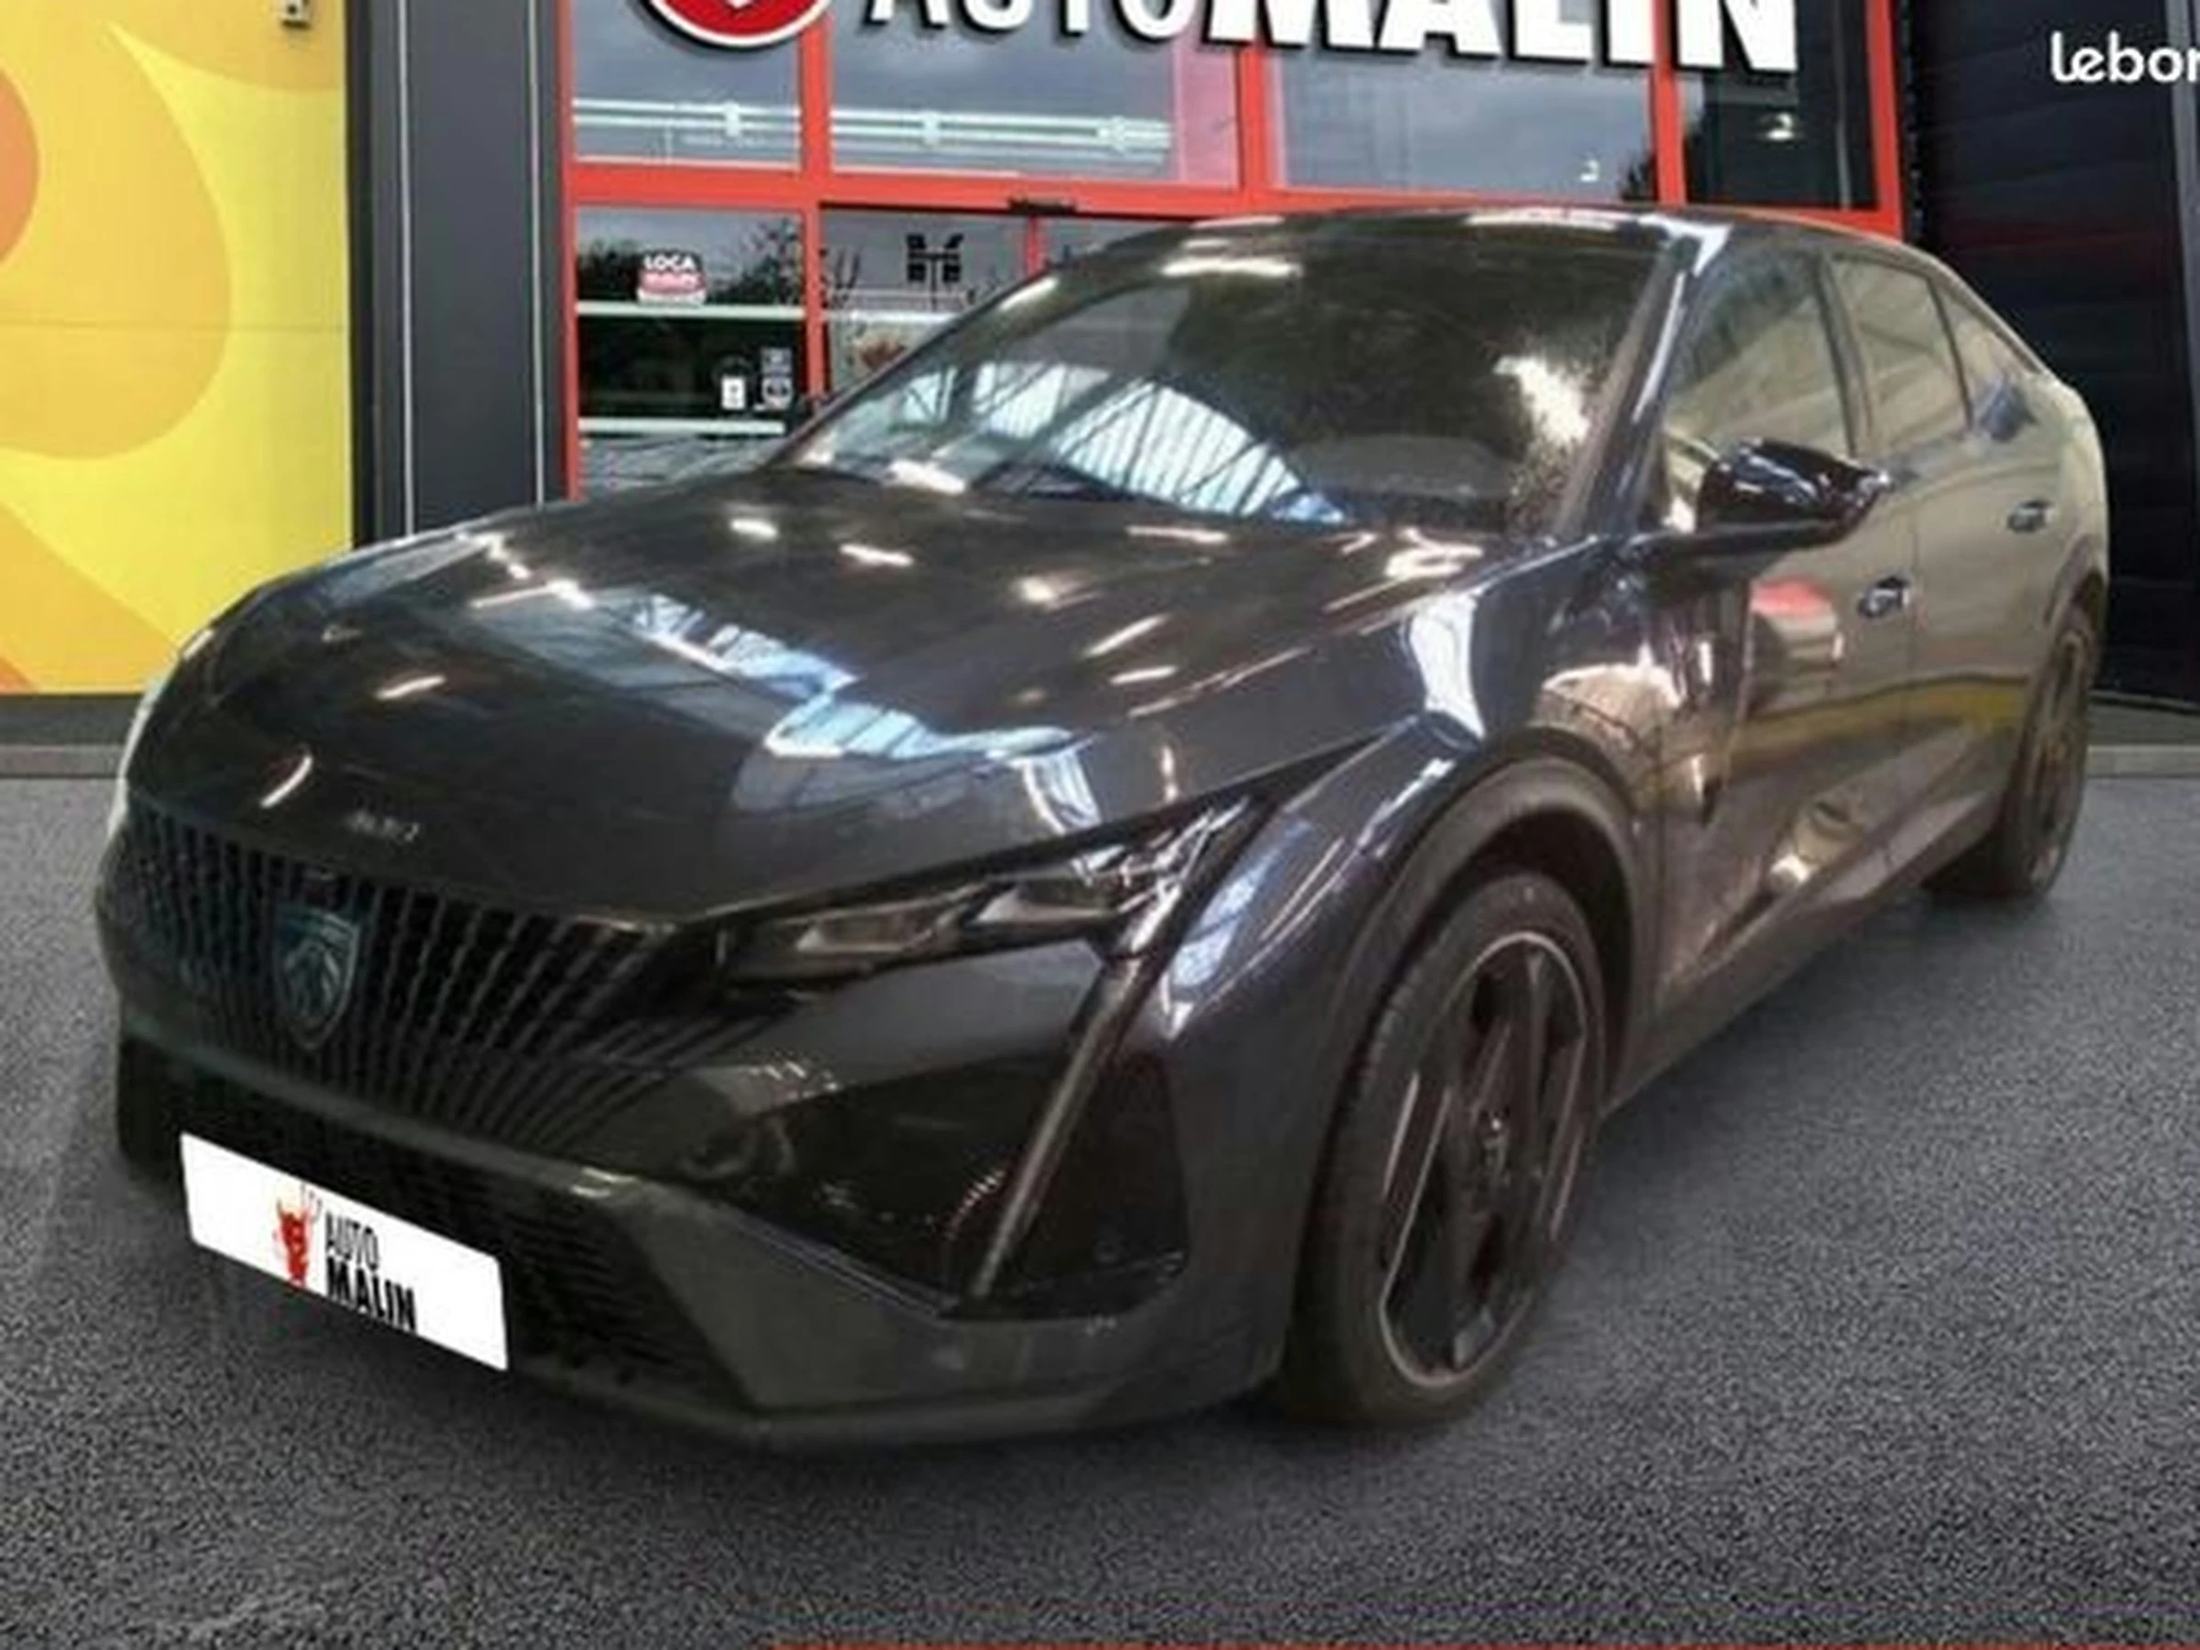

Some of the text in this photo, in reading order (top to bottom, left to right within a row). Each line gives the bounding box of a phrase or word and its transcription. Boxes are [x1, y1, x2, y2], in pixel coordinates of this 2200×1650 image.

[868, 0, 1798, 73] MALIN
[325, 1211, 379, 1272] AUTO
[326, 1256, 417, 1332] MALIN
